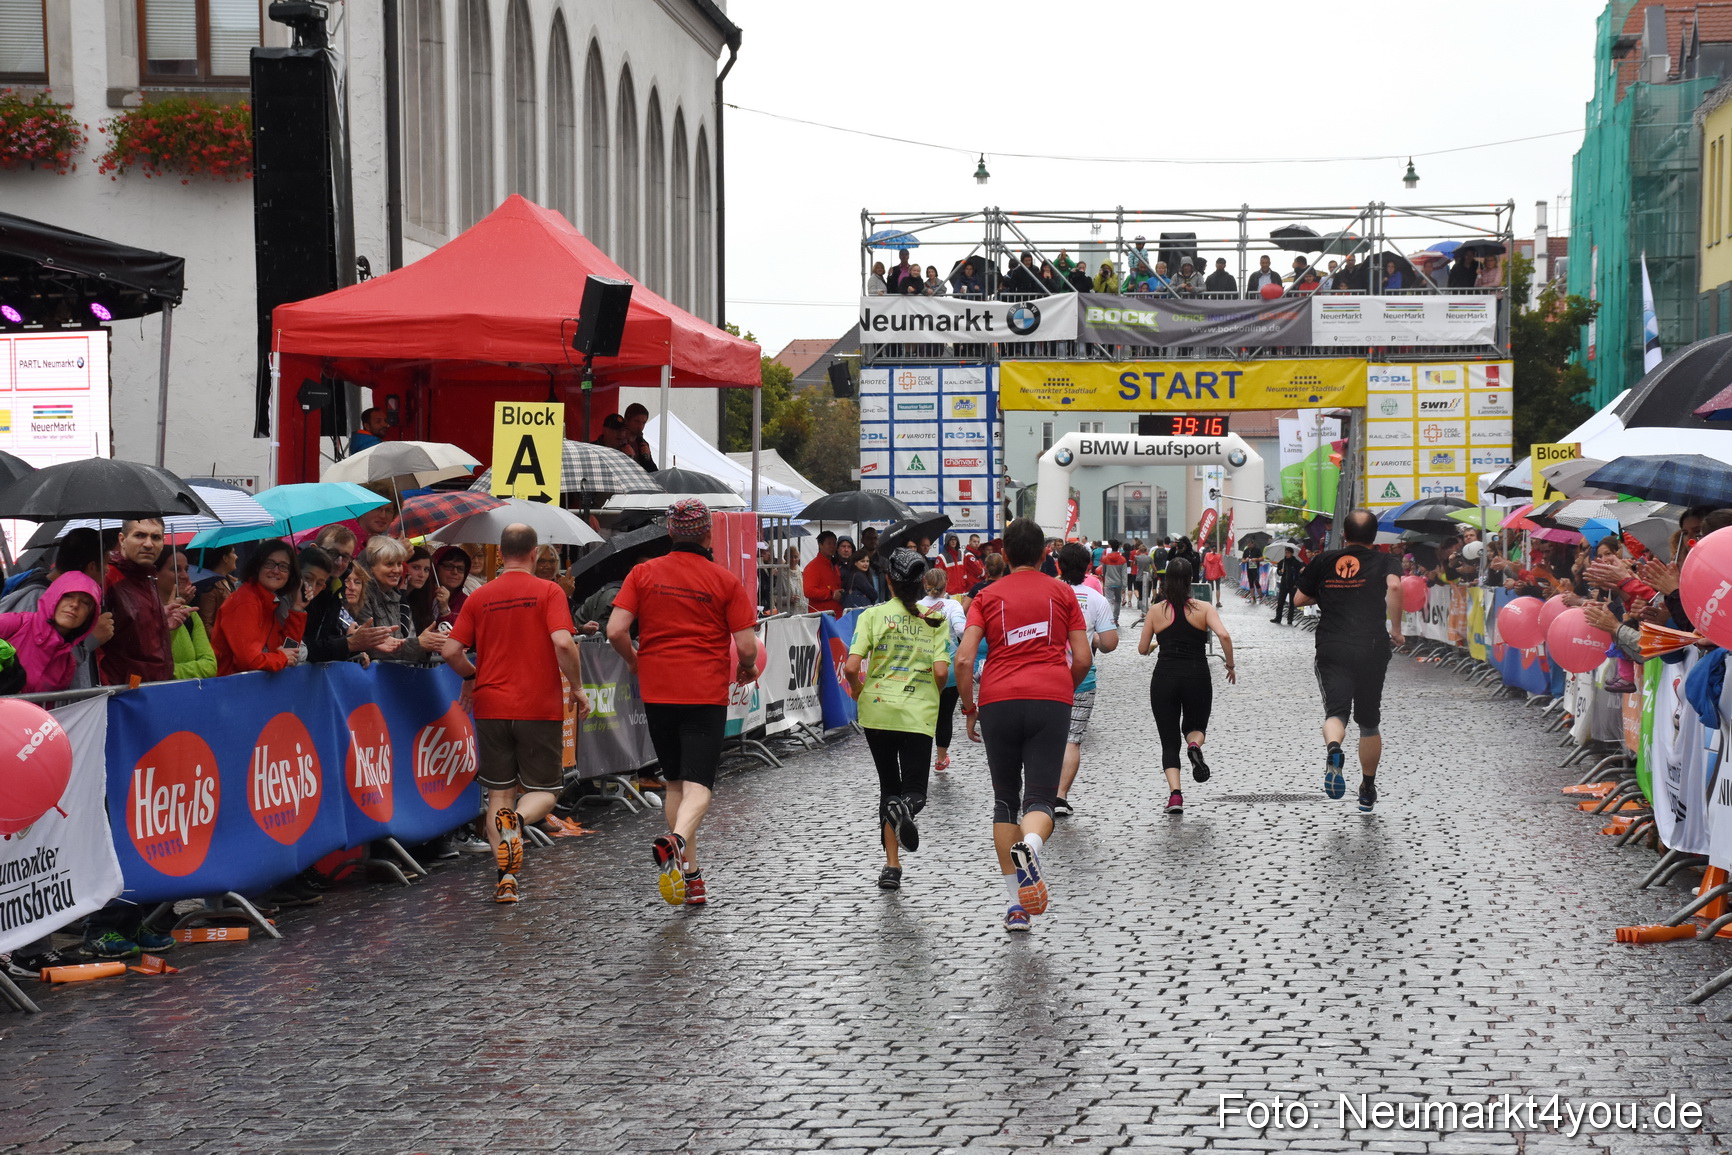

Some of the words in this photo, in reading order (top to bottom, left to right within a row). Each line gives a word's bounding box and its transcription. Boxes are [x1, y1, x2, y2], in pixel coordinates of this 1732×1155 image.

[1087, 308, 1156, 326] BOCK
[1172, 313, 1205, 323] OFFICE
[1320, 312, 1362, 321] NeuerMarkt
[1383, 312, 1425, 320] NeuerMarkt
[1446, 311, 1488, 320] NeuerMarkt
[1191, 324, 1281, 334] www.bockonline.de
[43, 358, 75, 369] Neumarkt
[1064, 386, 1097, 395] Stadtlauf
[1118, 371, 1243, 400] START
[1311, 385, 1346, 393] Stadtlauf
[1420, 401, 1448, 409] swn
[502, 406, 556, 426] Block
[1478, 408, 1508, 416] Lammsbräu
[31, 421, 76, 433] NeuerMarkt
[1171, 417, 1222, 436] 39:16
[1079, 440, 1129, 456] BMW
[1133, 440, 1221, 459] Laufsport
[1537, 446, 1576, 460] Block
[505, 434, 546, 486] A
[1381, 460, 1412, 468] VARIOTEC
[1199, 512, 1215, 541] REWE
[896, 624, 923, 637] LAUF
[1017, 627, 1038, 640] DEHN
[419, 725, 478, 787] Hervis
[256, 742, 319, 817] Hervis
[134, 764, 215, 845] Hervis
[264, 808, 298, 831] SPORTS
[145, 837, 183, 862] SPORTS
